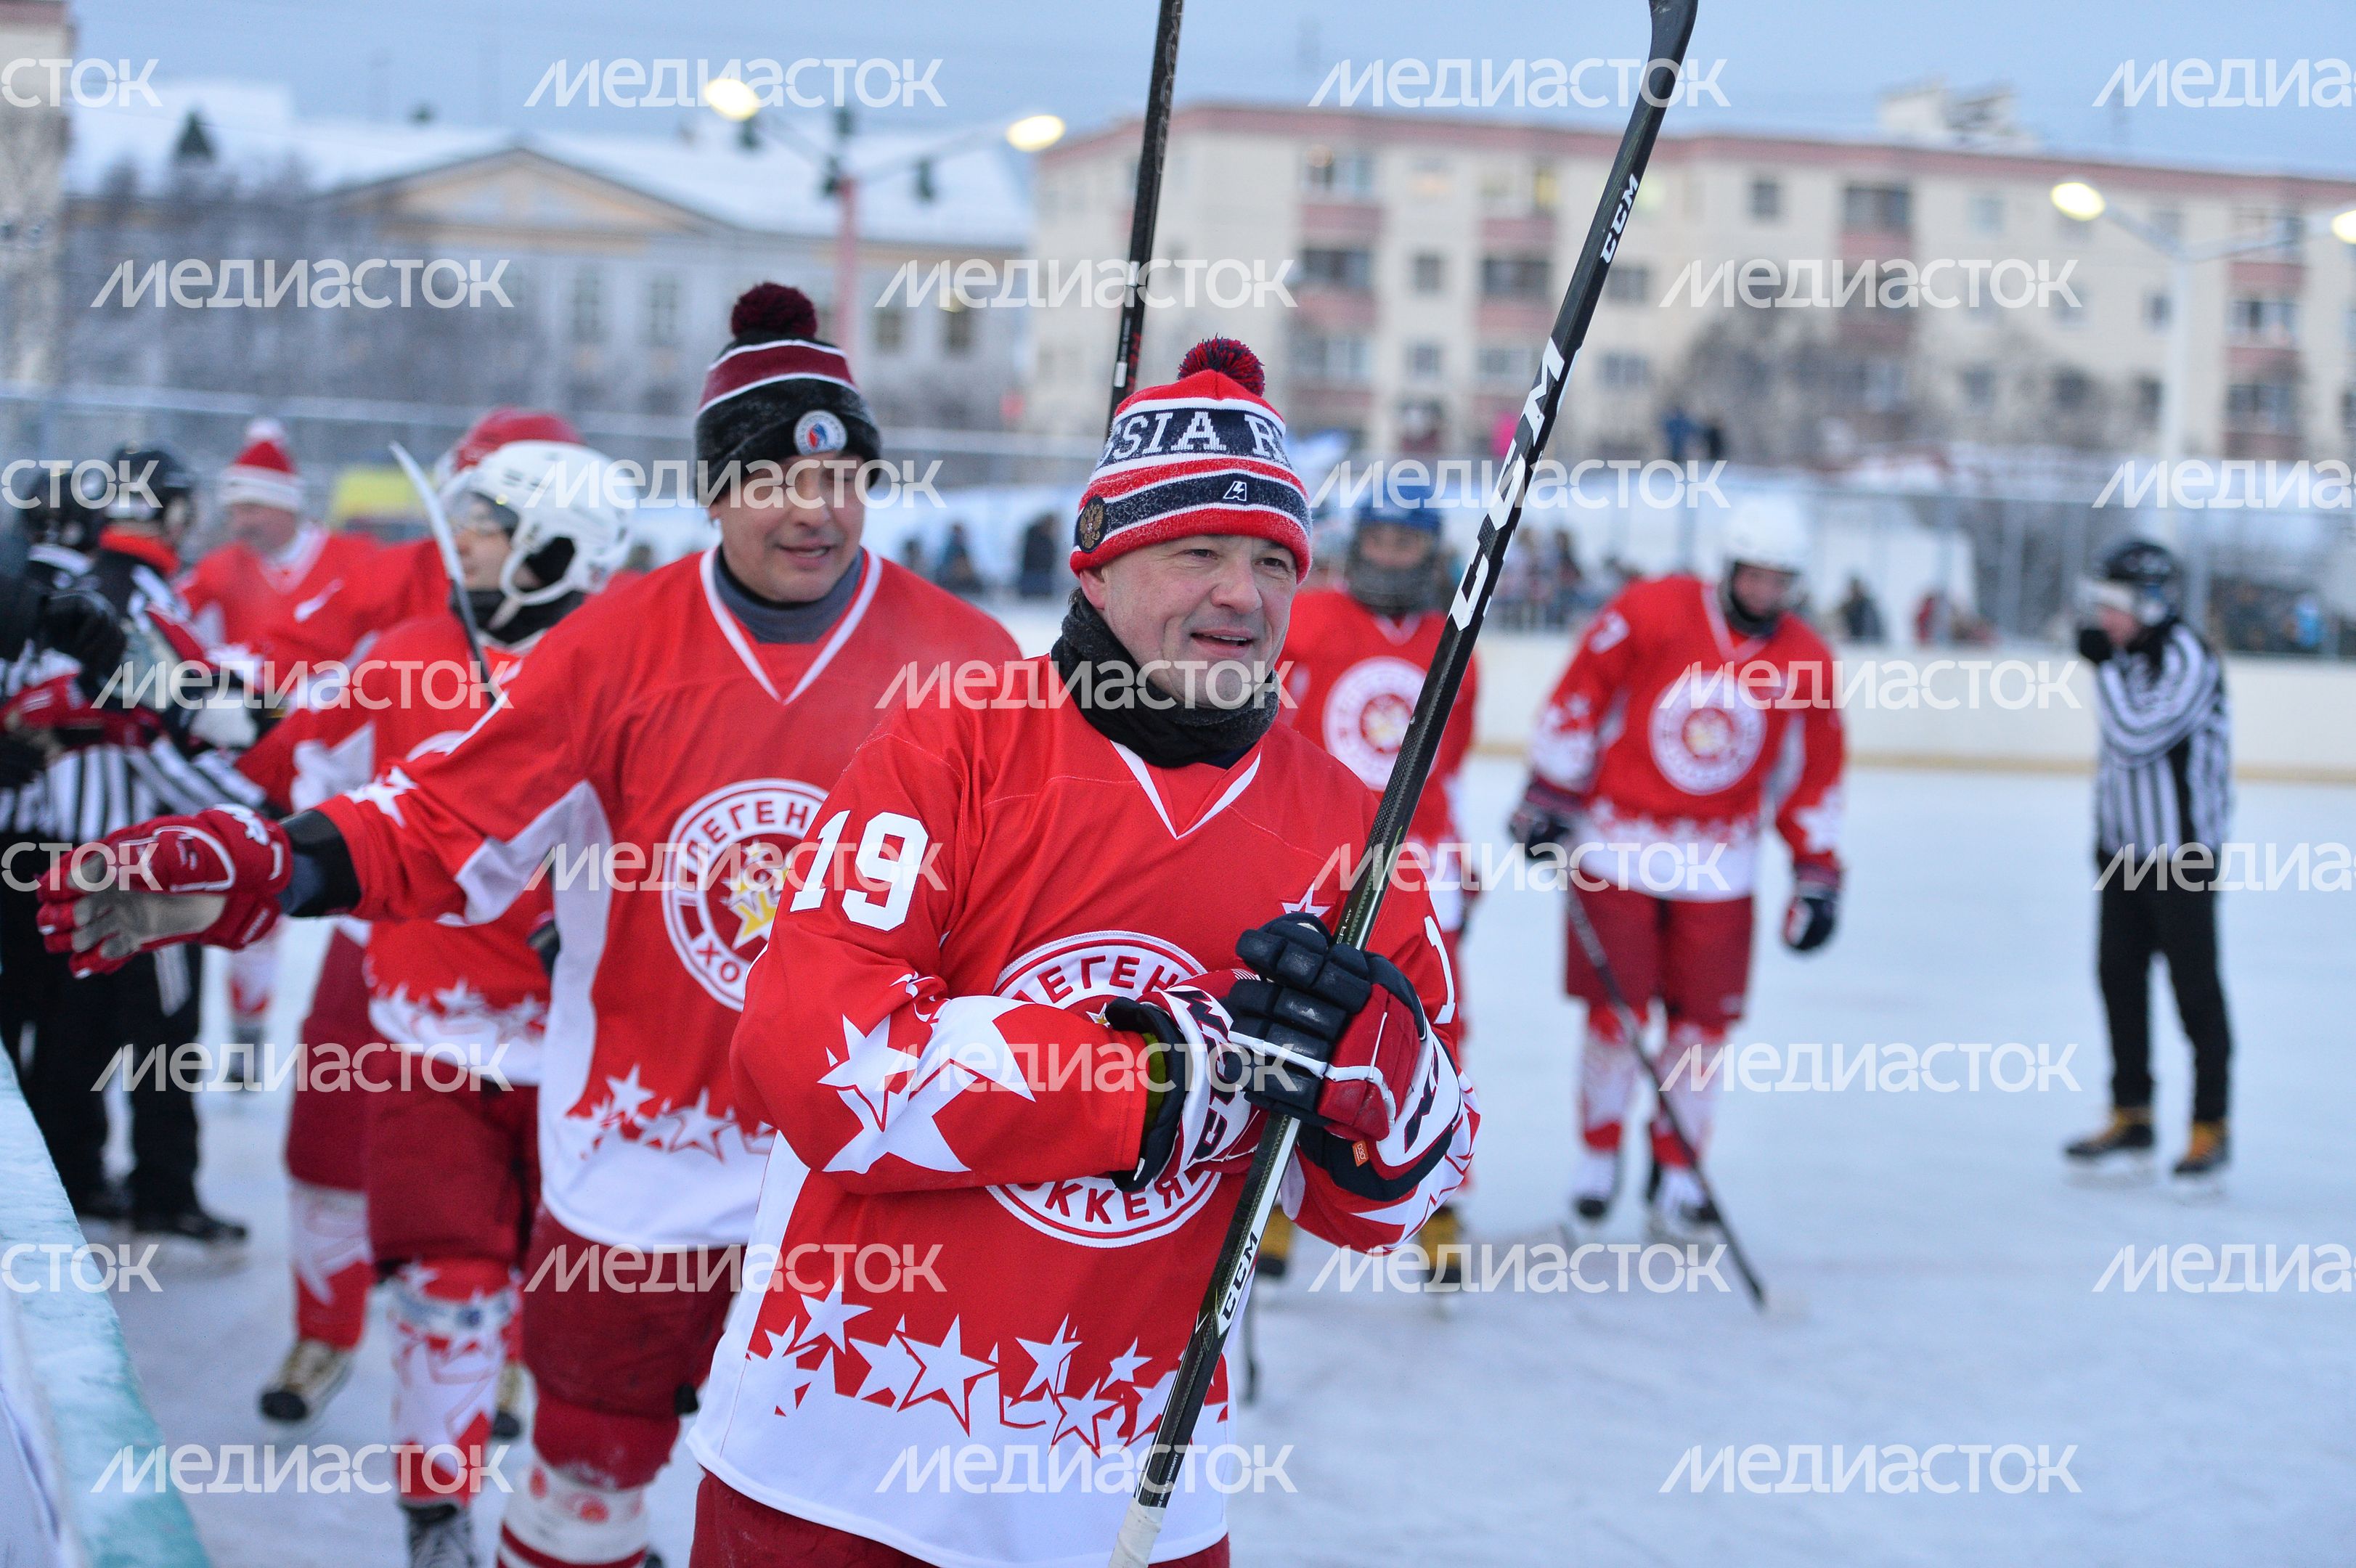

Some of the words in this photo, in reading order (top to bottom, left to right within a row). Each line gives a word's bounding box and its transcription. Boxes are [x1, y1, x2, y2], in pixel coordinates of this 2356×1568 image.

[1599, 173, 1639, 263] CCM
[789, 809, 929, 932] 19
[1221, 1231, 1259, 1322] CCM
